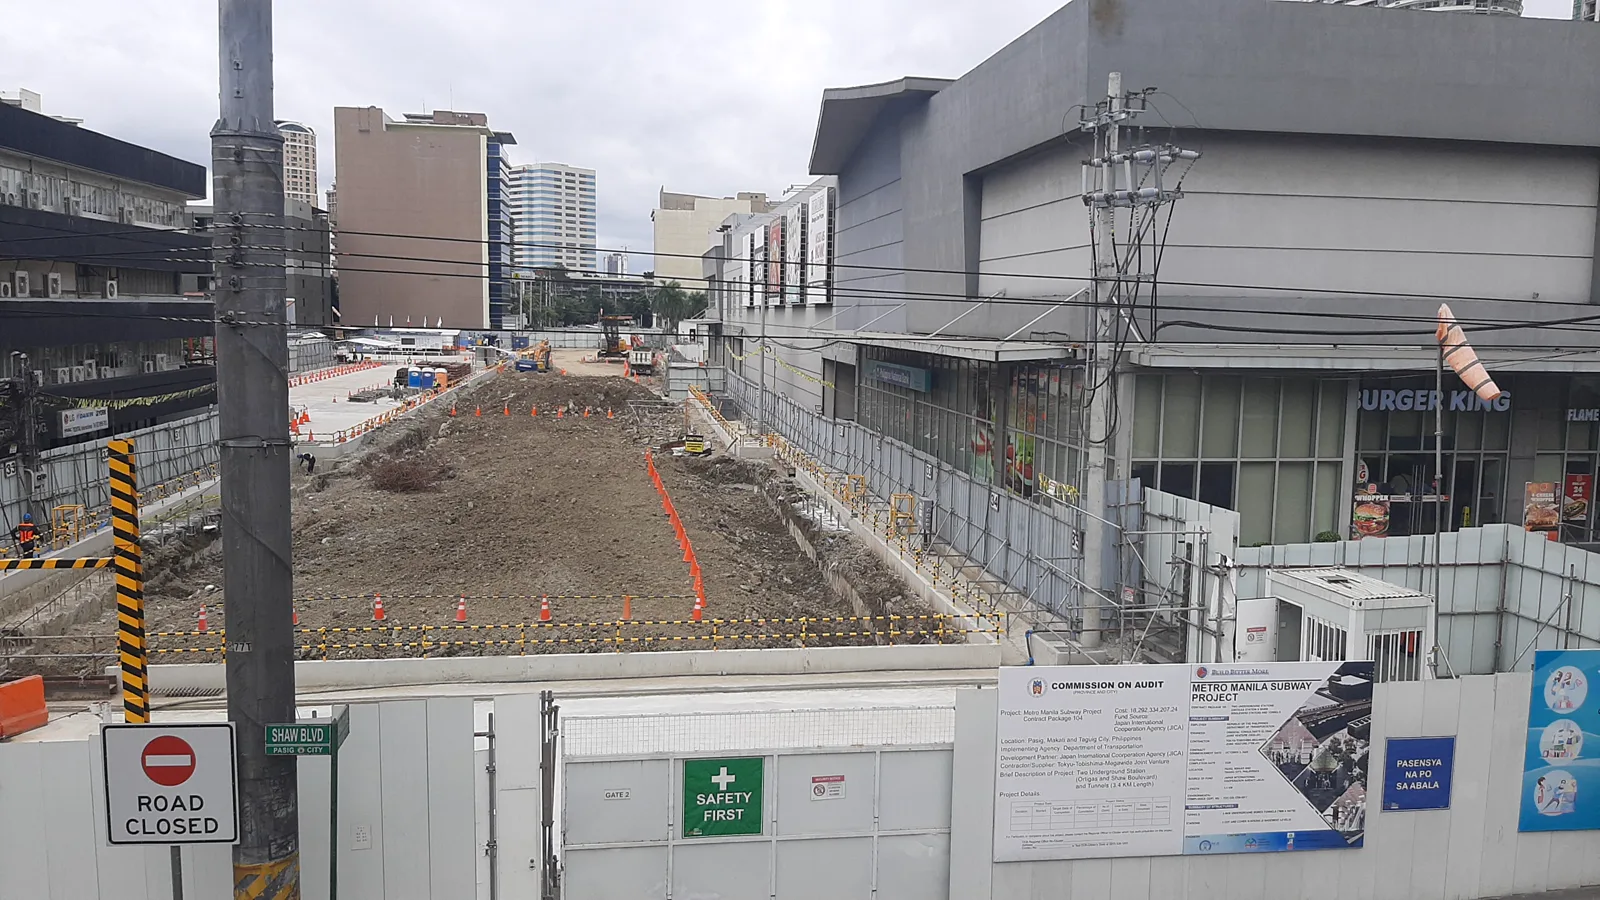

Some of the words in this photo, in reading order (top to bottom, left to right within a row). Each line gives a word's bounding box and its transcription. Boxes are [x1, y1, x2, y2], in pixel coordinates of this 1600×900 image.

[1567, 409, 1600, 421] FLAME
[6, 462, 16, 474] 33
[1051, 682, 1115, 690] COMMISSION
[1118, 681, 1132, 689] ON
[1134, 680, 1164, 688] AUDIT
[1192, 683, 1228, 692] METRO
[1230, 683, 1268, 692] MANILA
[1270, 682, 1312, 691] SUBWAY
[1192, 693, 1238, 702] PROJECT
[272, 728, 298, 742] SHAW
[301, 728, 324, 742] BLVD
[1396, 759, 1442, 768] PASENSYA
[1420, 770, 1432, 778] PO
[1410, 781, 1439, 790] ABALA
[138, 795, 204, 812] ROAD
[696, 792, 752, 805] SAFETY
[704, 809, 745, 822] FIRST
[126, 818, 218, 835] CLOSED
